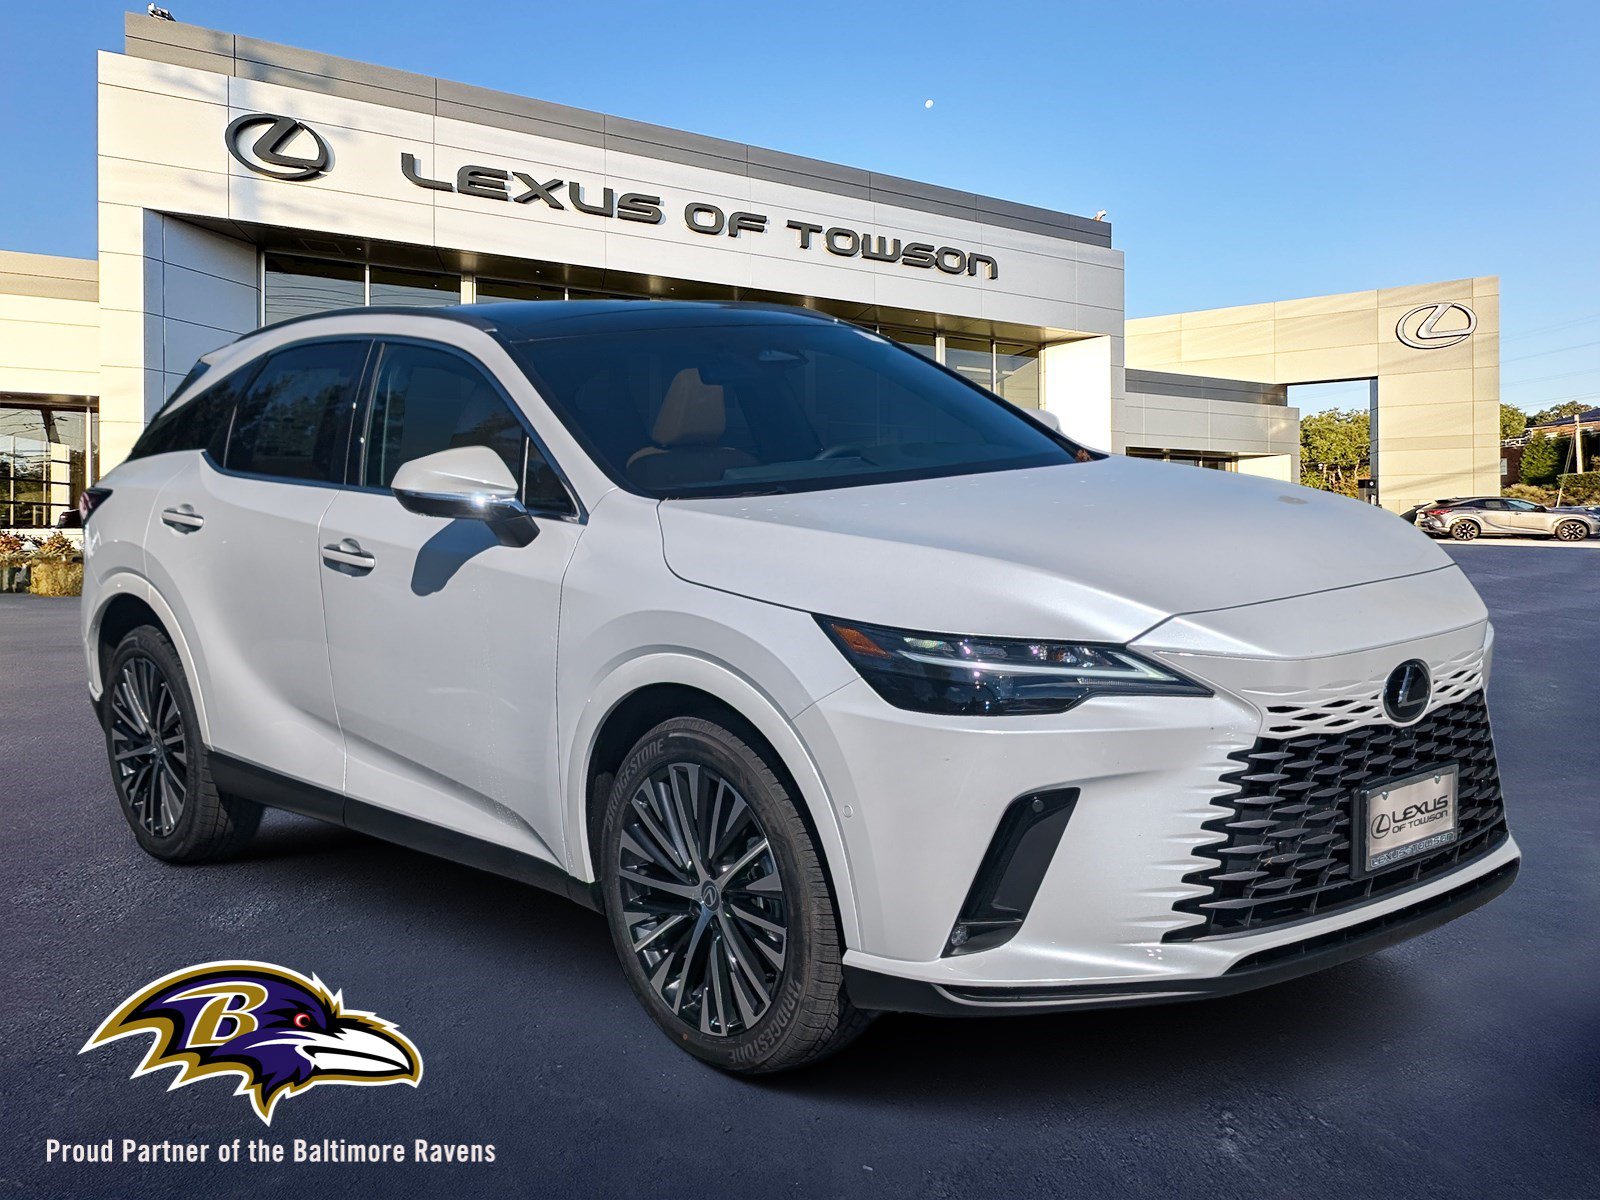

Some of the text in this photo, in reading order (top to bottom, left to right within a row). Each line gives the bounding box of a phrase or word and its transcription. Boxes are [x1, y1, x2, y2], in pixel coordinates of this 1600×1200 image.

[401, 152, 1000, 281] LEXUS OF TOWSON
[1392, 795, 1448, 823] LEXUS
[1392, 810, 1448, 834] OF TOWSON
